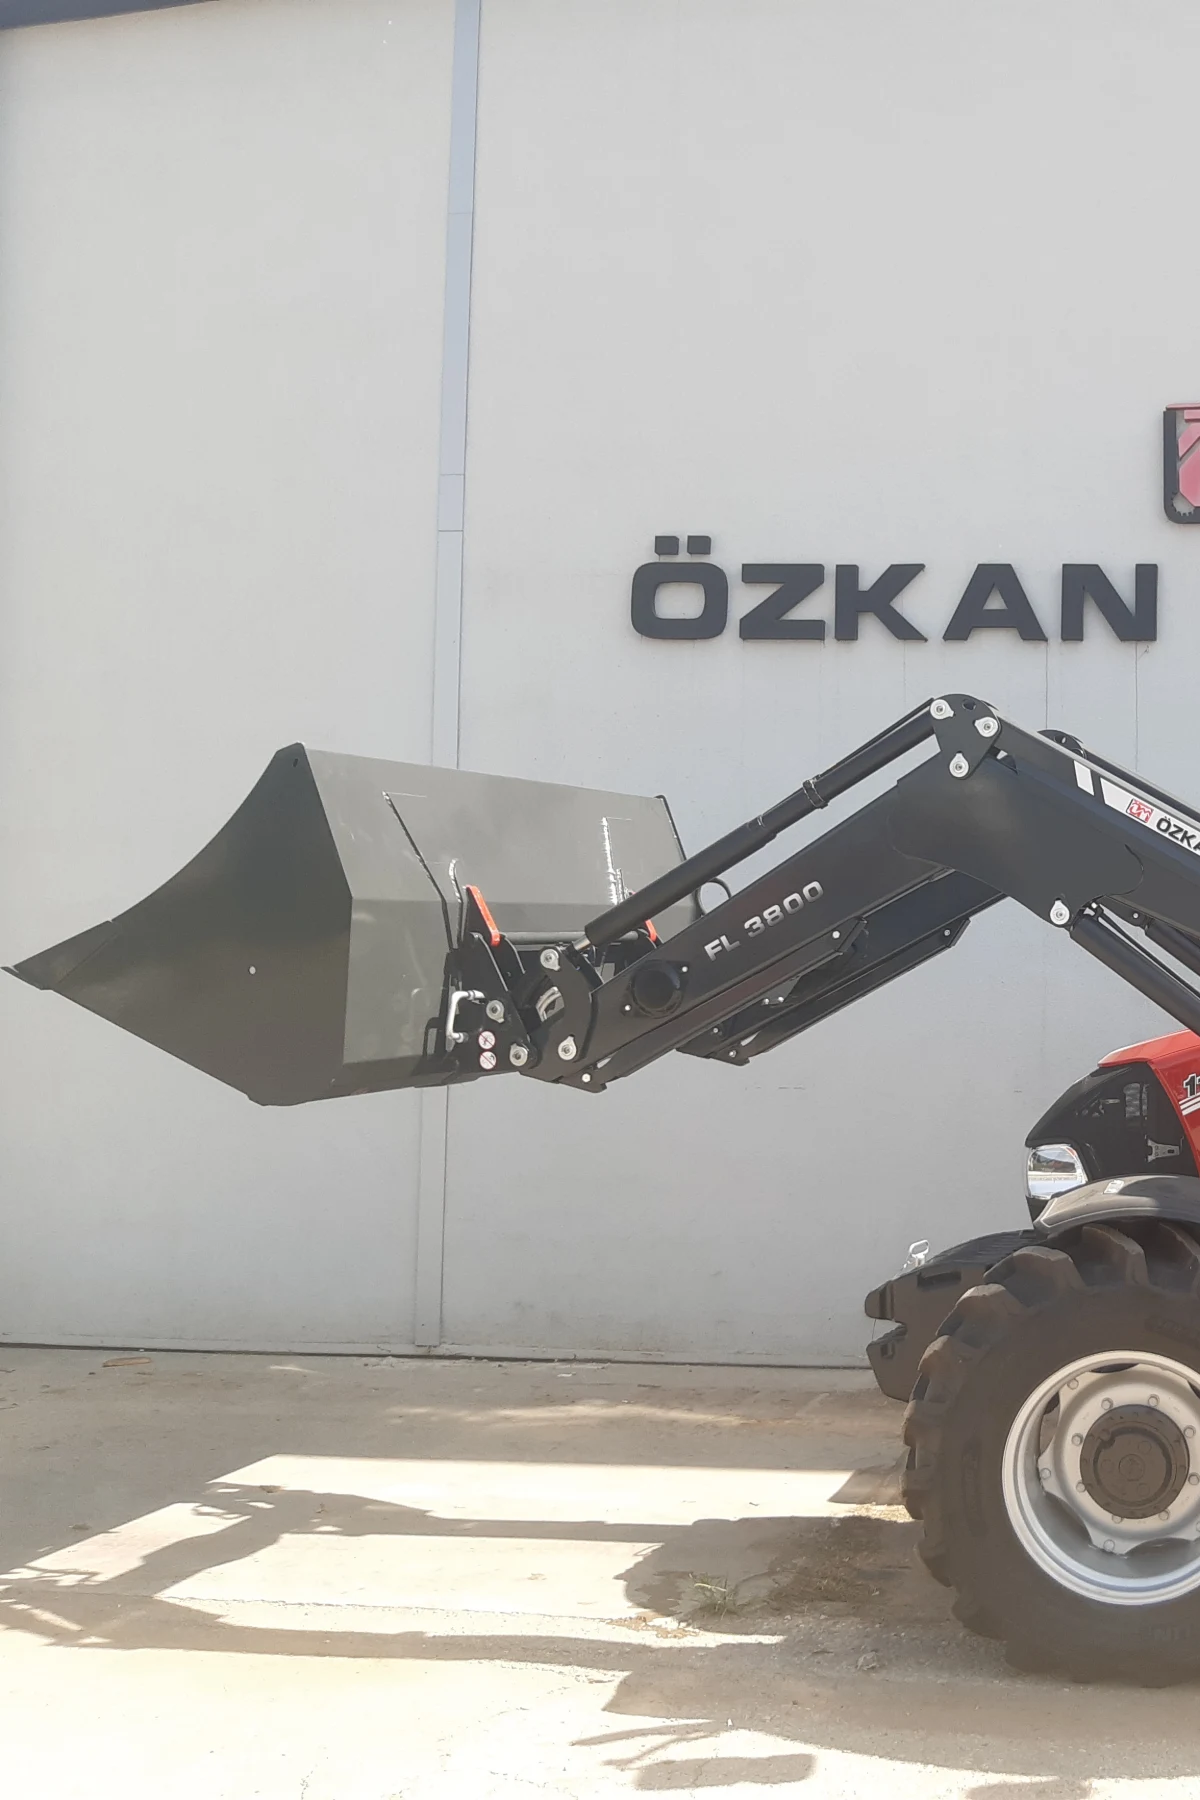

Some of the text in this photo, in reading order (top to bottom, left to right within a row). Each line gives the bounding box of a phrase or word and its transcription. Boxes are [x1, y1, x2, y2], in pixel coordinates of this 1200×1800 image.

[631, 535, 1159, 642] ÖZKAN
[704, 880, 824, 962] FL 3800
